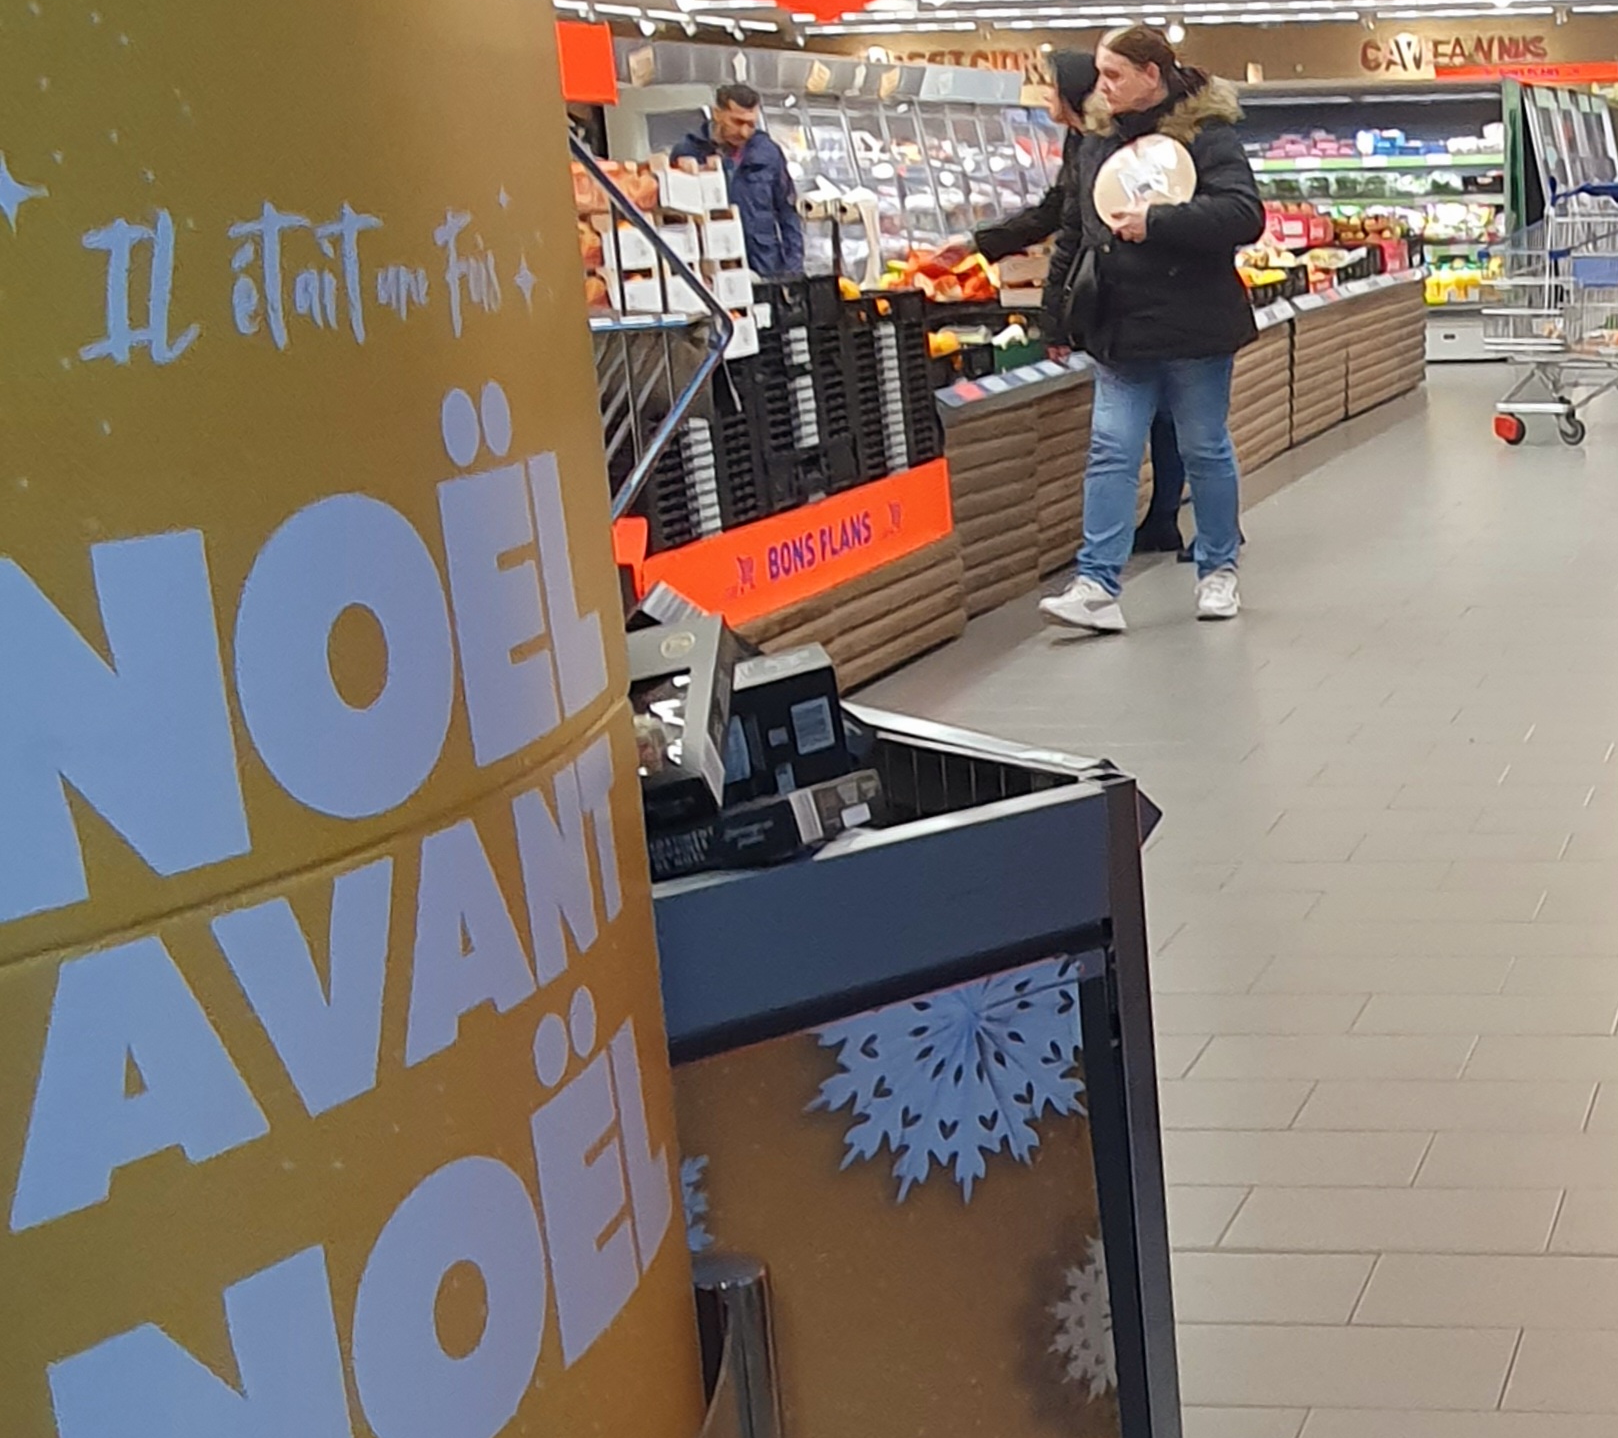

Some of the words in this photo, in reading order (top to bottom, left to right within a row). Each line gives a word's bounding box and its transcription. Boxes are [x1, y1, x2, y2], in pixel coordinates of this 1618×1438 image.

[0, 382, 609, 924] NOËL
[768, 532, 815, 581] BONS
[819, 510, 872, 562] PLANS
[8, 729, 626, 1233] AVANT
